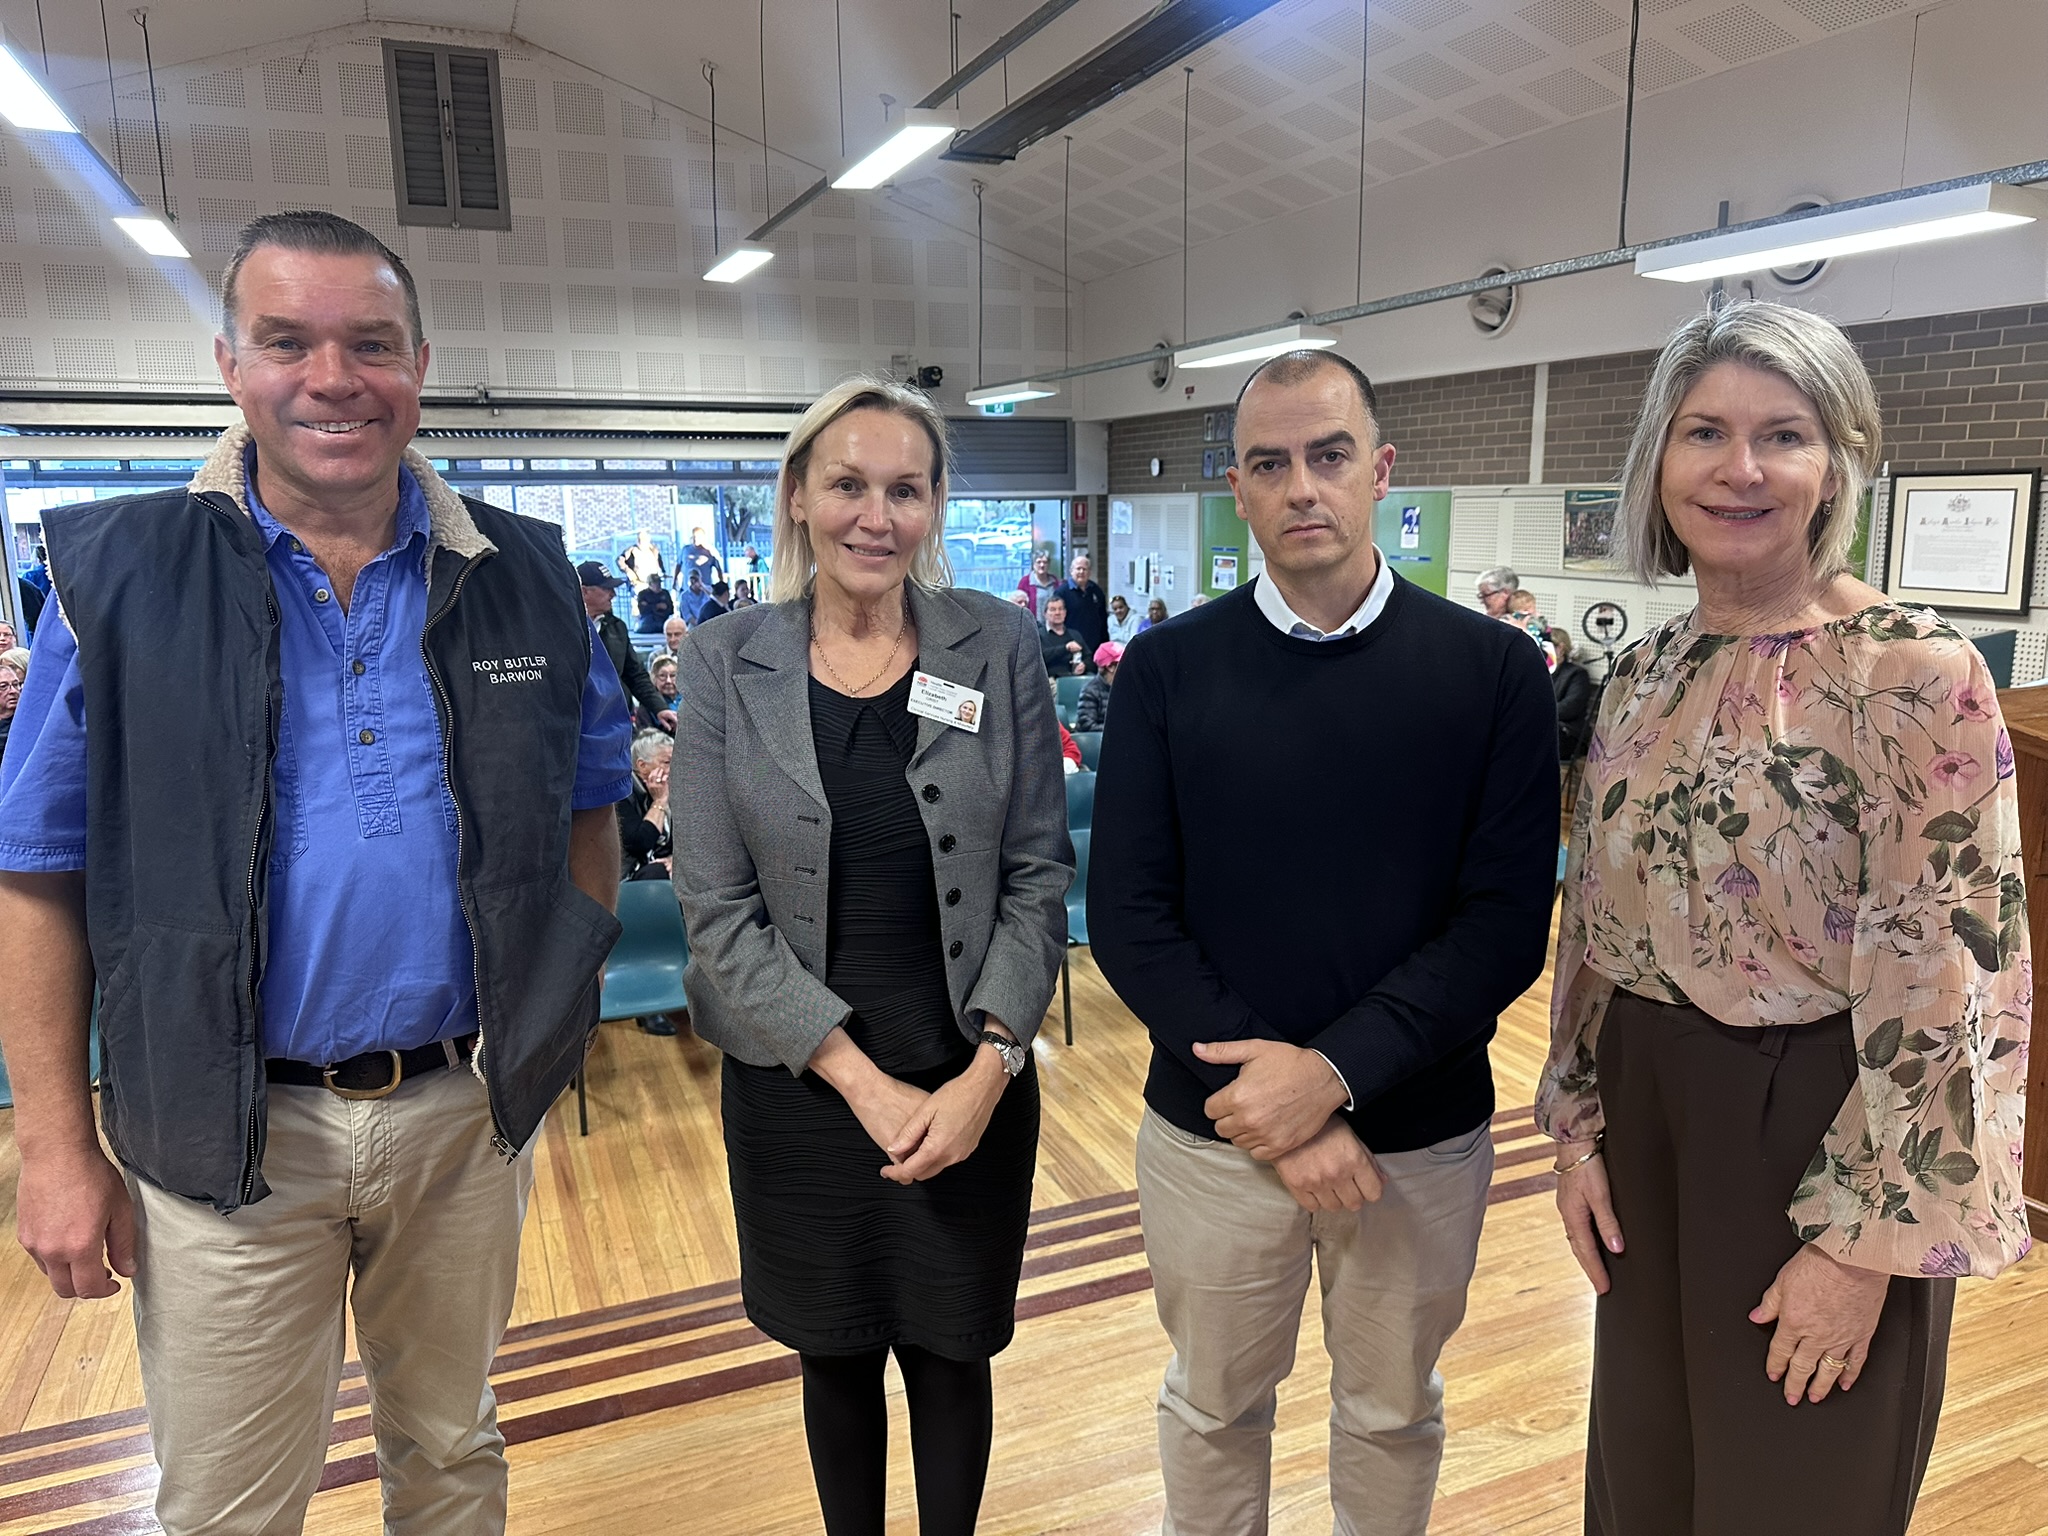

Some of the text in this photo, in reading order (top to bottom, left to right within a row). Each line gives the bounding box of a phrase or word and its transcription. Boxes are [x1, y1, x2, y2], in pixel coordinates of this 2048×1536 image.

[472, 656, 547, 672] ROY BUTLER
[489, 670, 542, 683] BARWON
[921, 689, 947, 701] Elizabeth
